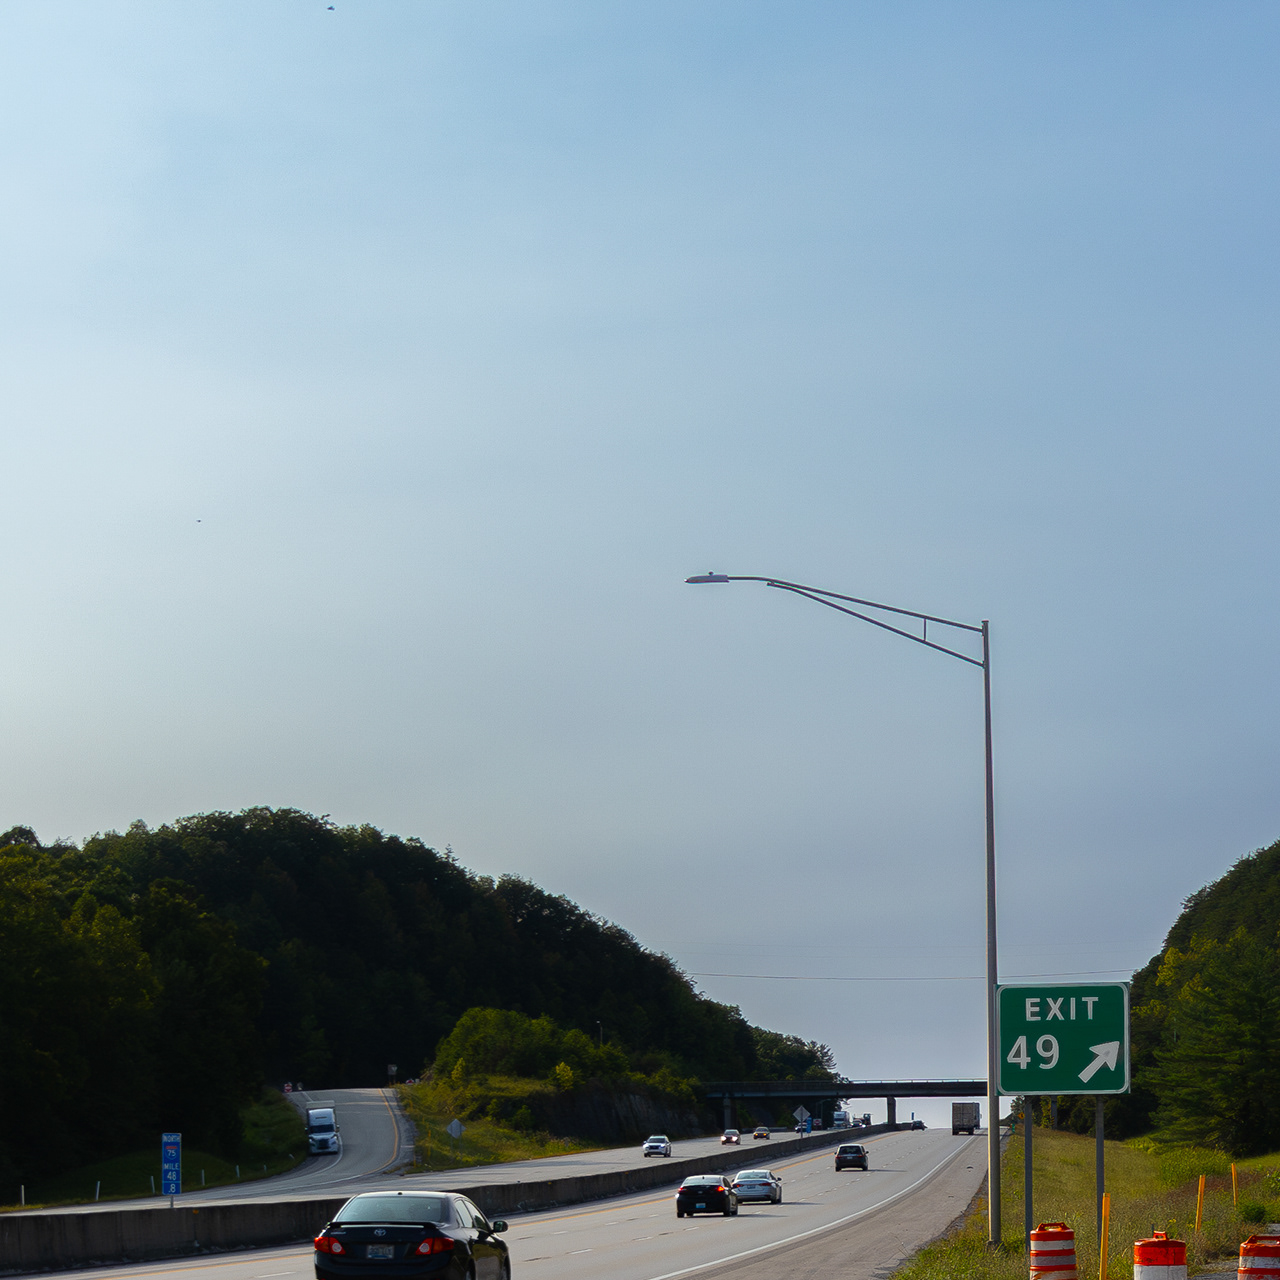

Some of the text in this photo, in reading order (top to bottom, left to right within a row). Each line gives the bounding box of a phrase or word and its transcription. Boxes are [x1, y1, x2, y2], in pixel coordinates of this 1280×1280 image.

[1025, 996, 1099, 1021] EXIT
[1006, 1034, 1060, 1070] 49
[167, 1149, 176, 1157] 75
[163, 1162, 180, 1170] MILE
[166, 1171, 177, 1181] 48
